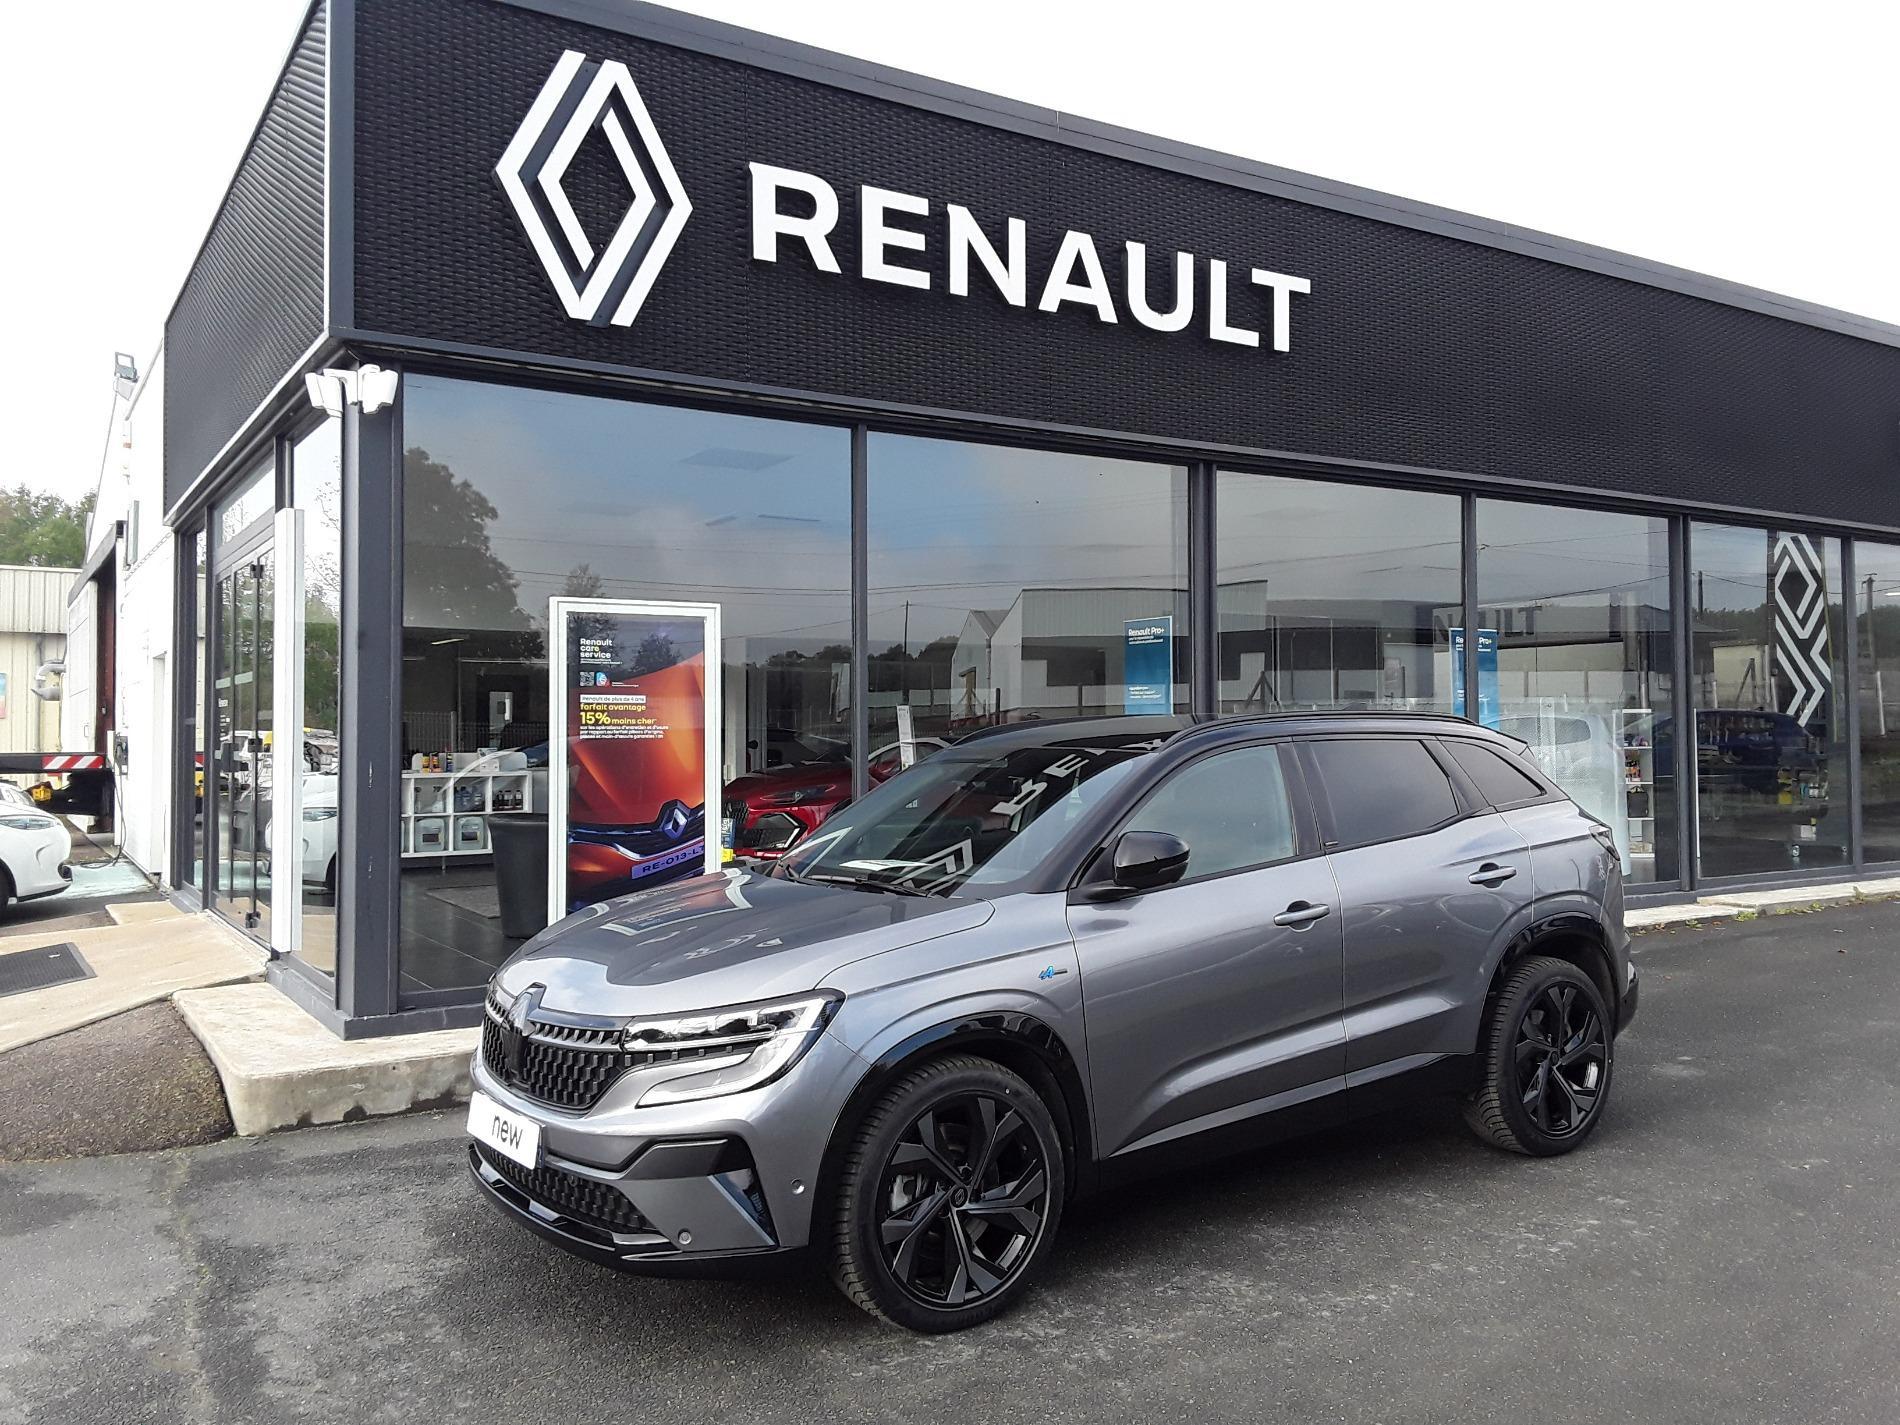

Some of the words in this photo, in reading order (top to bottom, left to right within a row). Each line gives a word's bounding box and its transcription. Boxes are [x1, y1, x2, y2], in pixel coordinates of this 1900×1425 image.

[749, 161, 1311, 353] RENAULT
[1128, 627, 1151, 637] Renault
[580, 638, 613, 646] Renault
[580, 651, 611, 659] service
[580, 703, 608, 711] forfait
[608, 704, 647, 712] avantage
[580, 711, 611, 725] 15%
[612, 717, 636, 725] moins
[491, 1114, 524, 1150] new
